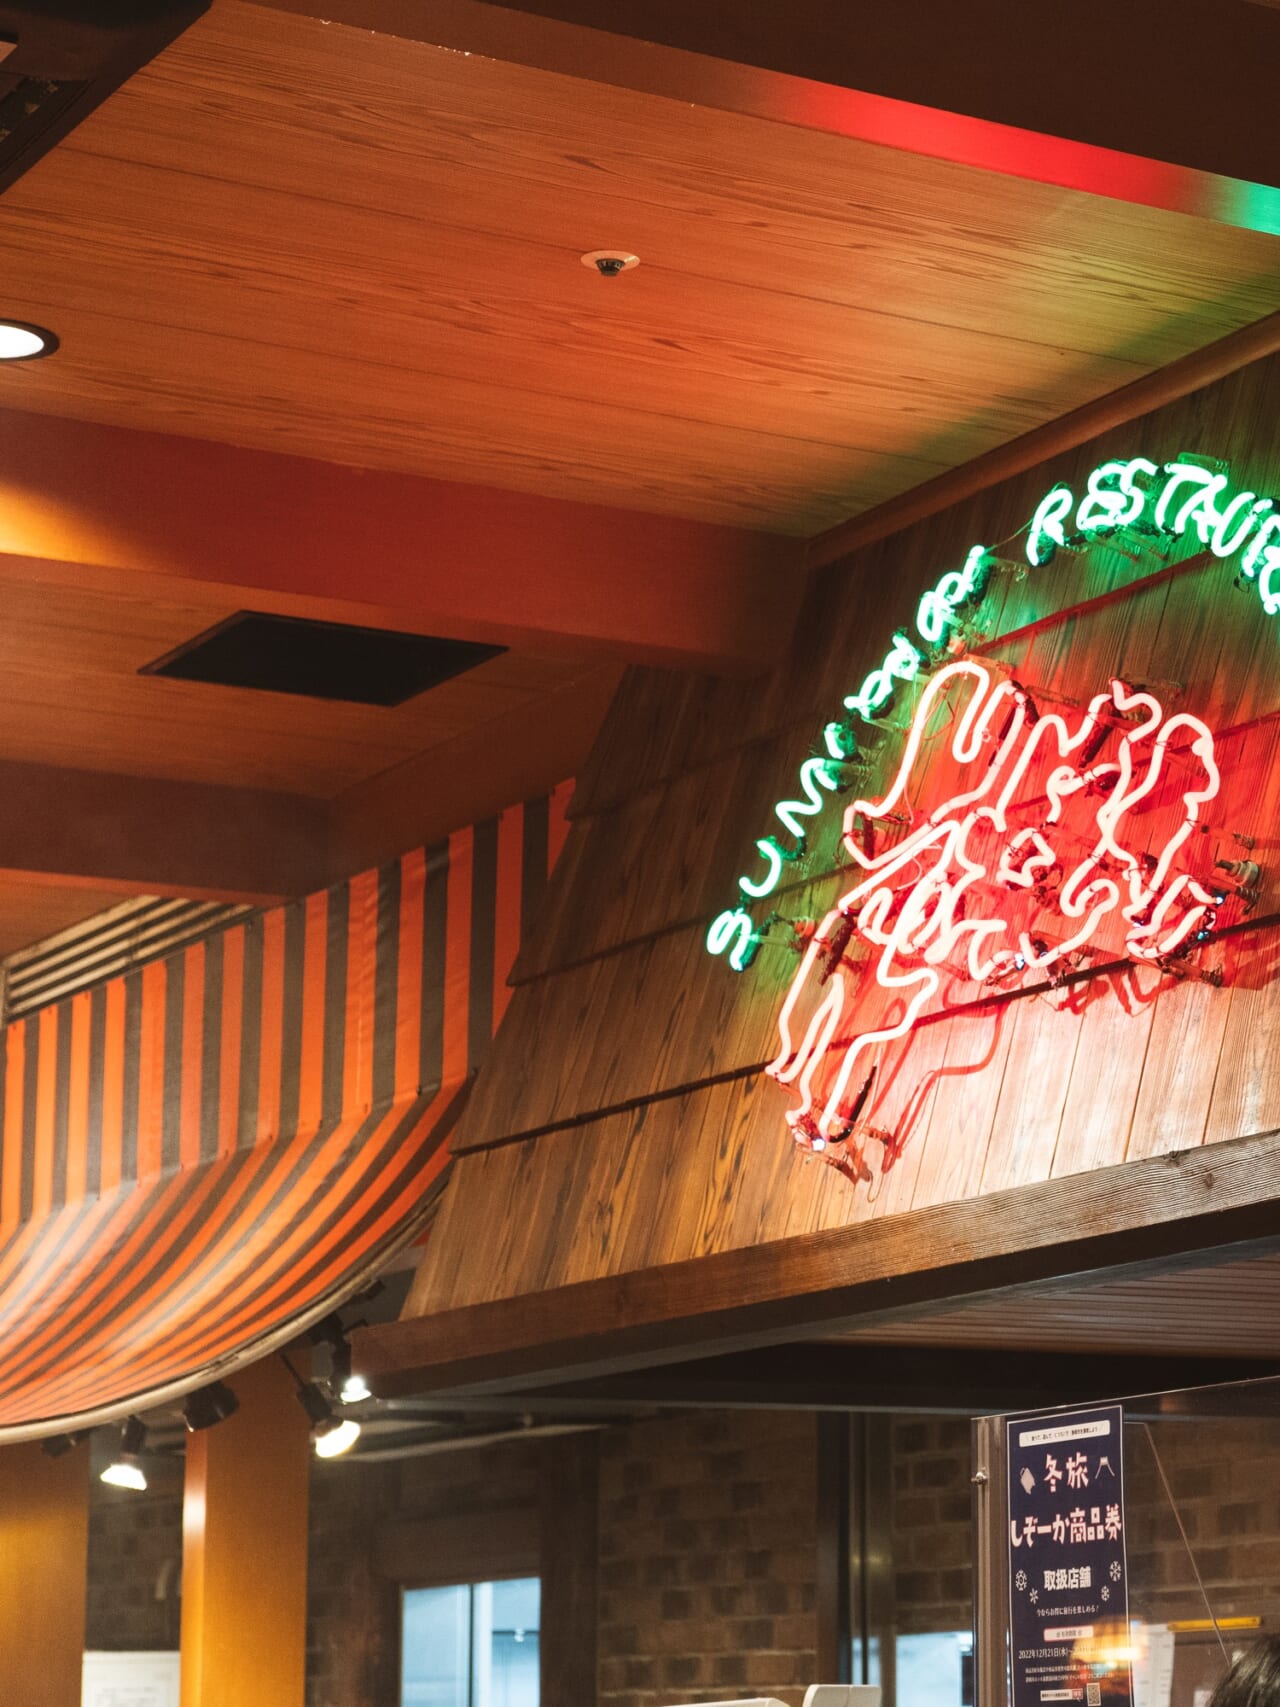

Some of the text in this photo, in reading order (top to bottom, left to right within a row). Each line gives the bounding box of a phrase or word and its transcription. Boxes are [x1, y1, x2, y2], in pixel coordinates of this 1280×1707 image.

[1043, 1451, 1089, 1493] 冬旅
[1010, 1503, 1122, 1548] しぞーか商品券
[1043, 1566, 1092, 1592] 取扱店舗
